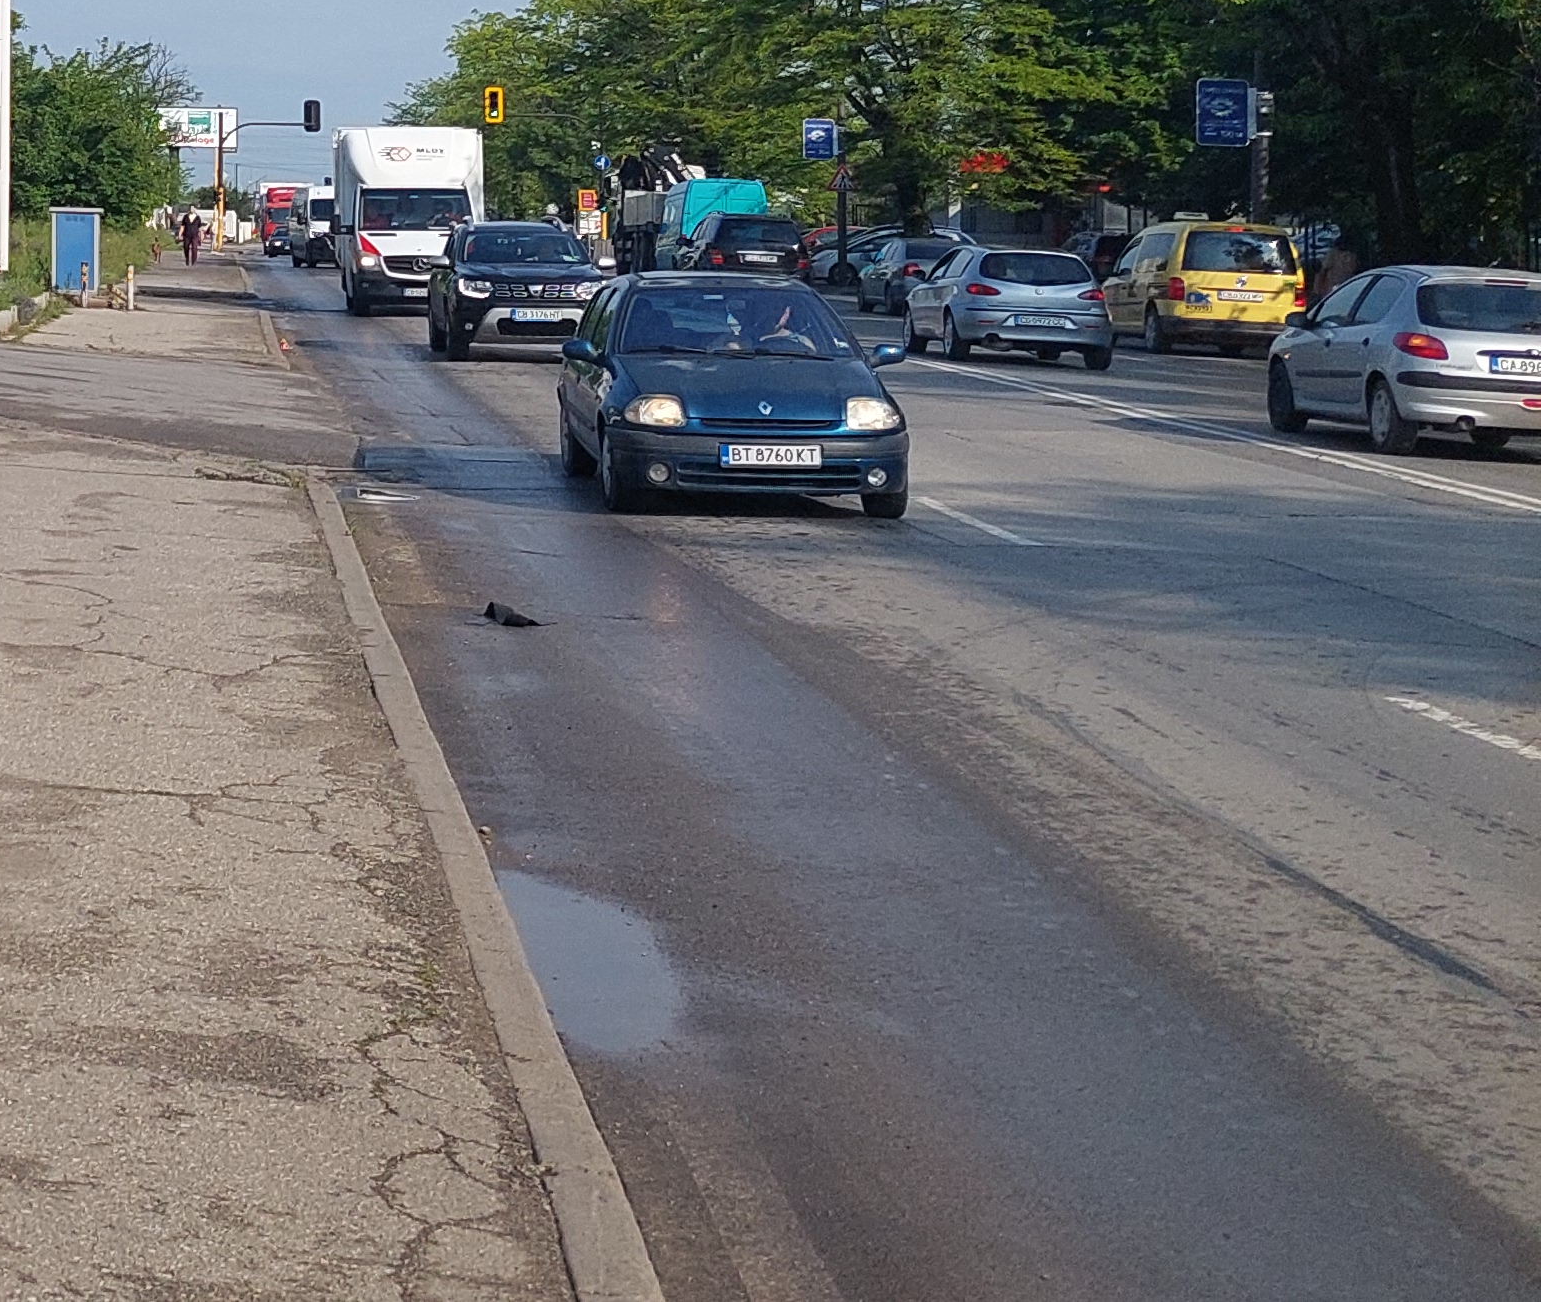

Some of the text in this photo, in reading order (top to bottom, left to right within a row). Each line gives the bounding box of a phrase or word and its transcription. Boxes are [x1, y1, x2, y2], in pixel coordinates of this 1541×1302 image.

[732, 447, 817, 463] BT 8760 KT
